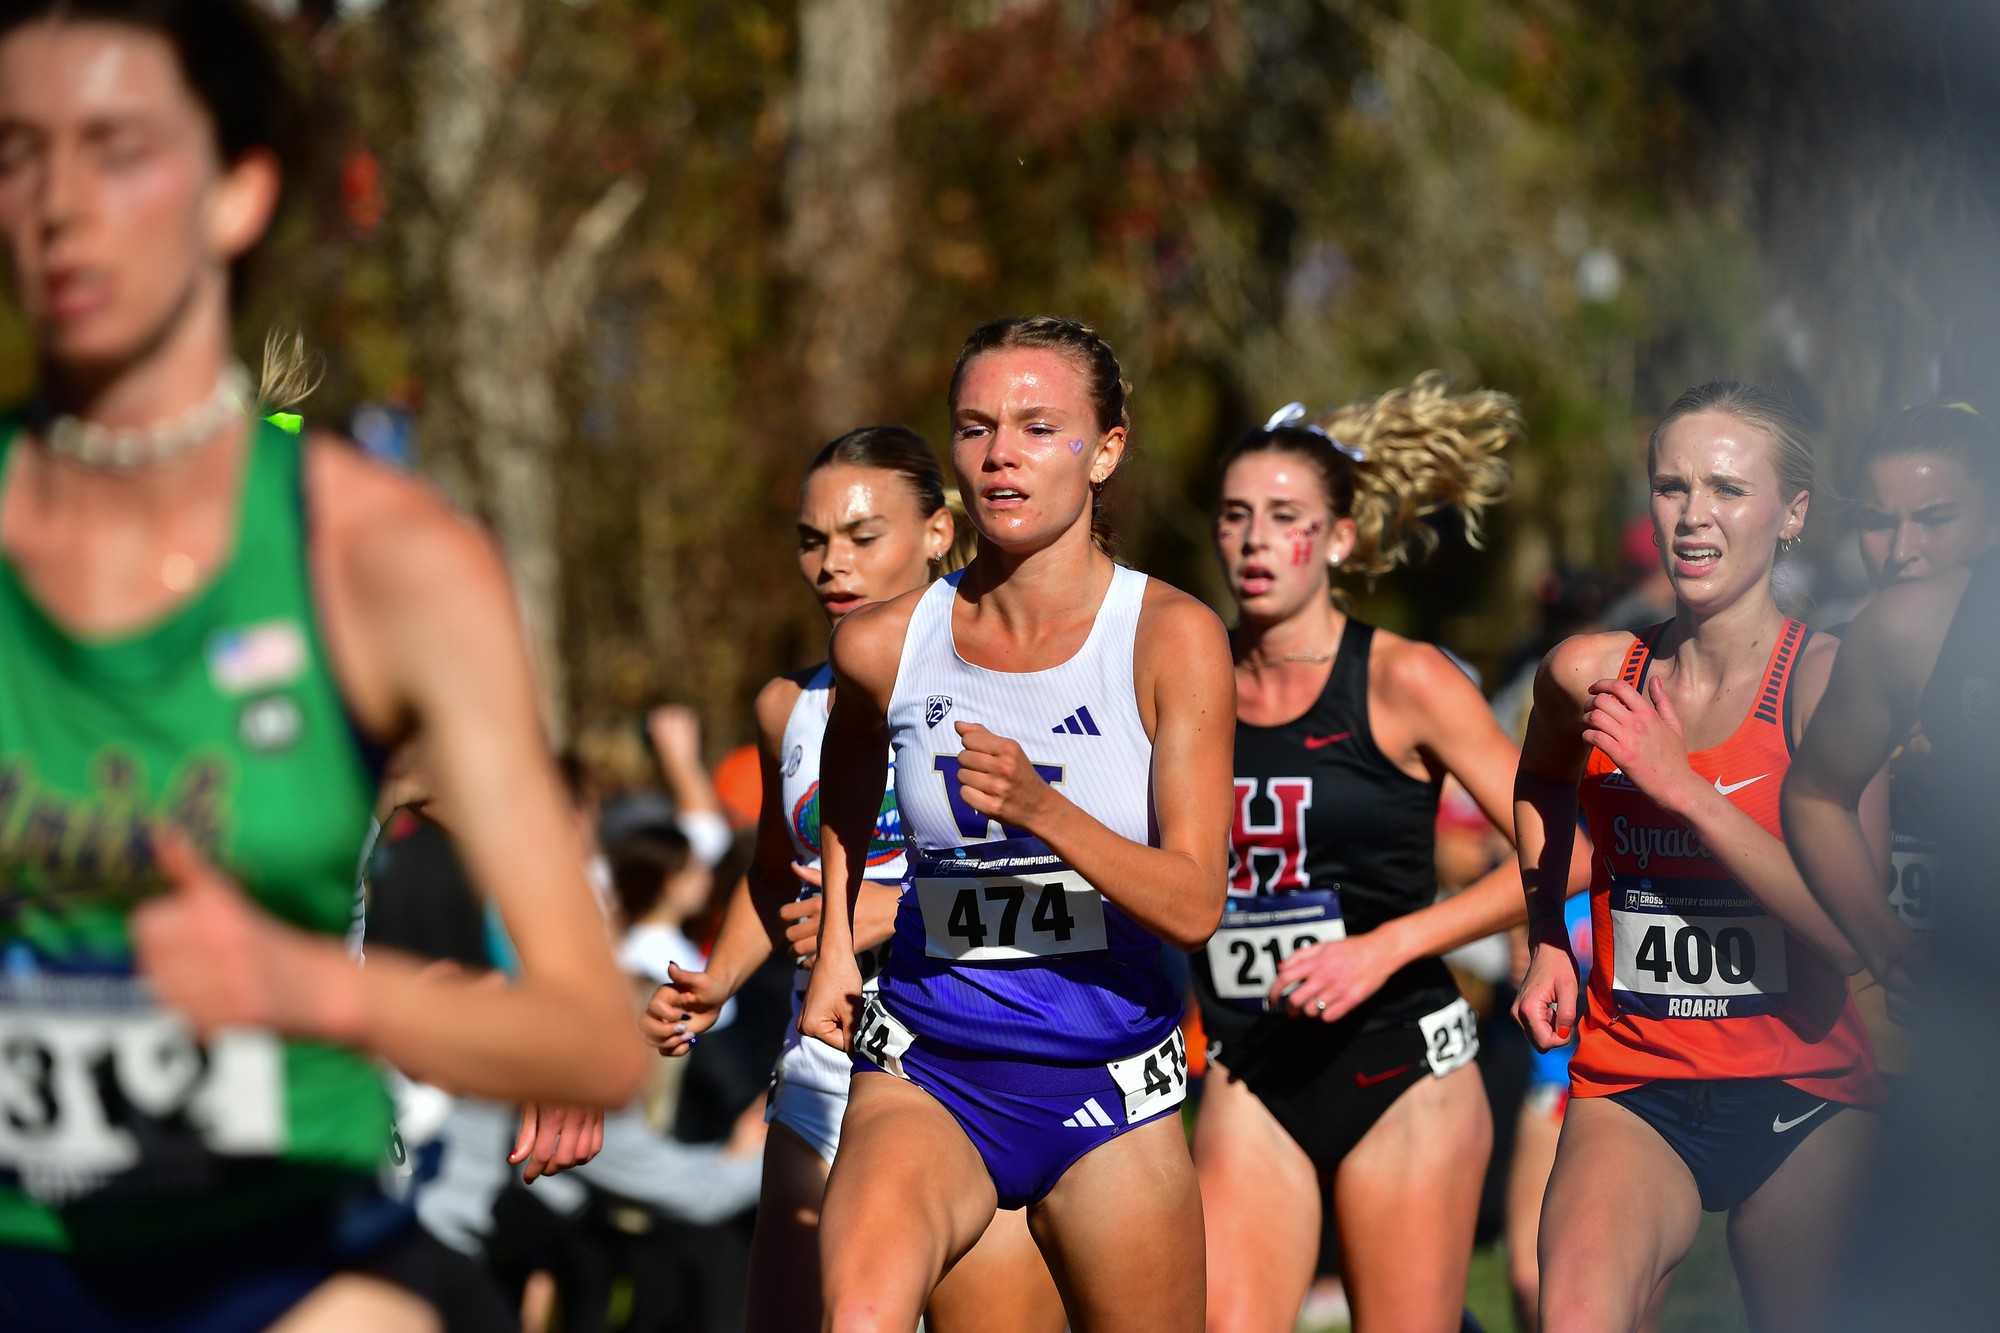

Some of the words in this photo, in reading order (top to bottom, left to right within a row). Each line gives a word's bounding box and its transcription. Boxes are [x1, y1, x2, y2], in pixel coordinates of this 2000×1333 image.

[926, 696, 952, 716] PAC
[927, 710, 942, 722] 12
[1228, 777, 1312, 897] H
[978, 858, 1010, 869] COUNTRY
[1009, 855, 1062, 867] CHAMPIONSH
[1639, 895, 1664, 905] CROSS
[1665, 896, 1698, 907] COUNTRY
[947, 882, 1075, 948] 474
[1230, 935, 1320, 985] 21
[1635, 924, 1757, 985] 400
[1668, 998, 1730, 1017] ROARK
